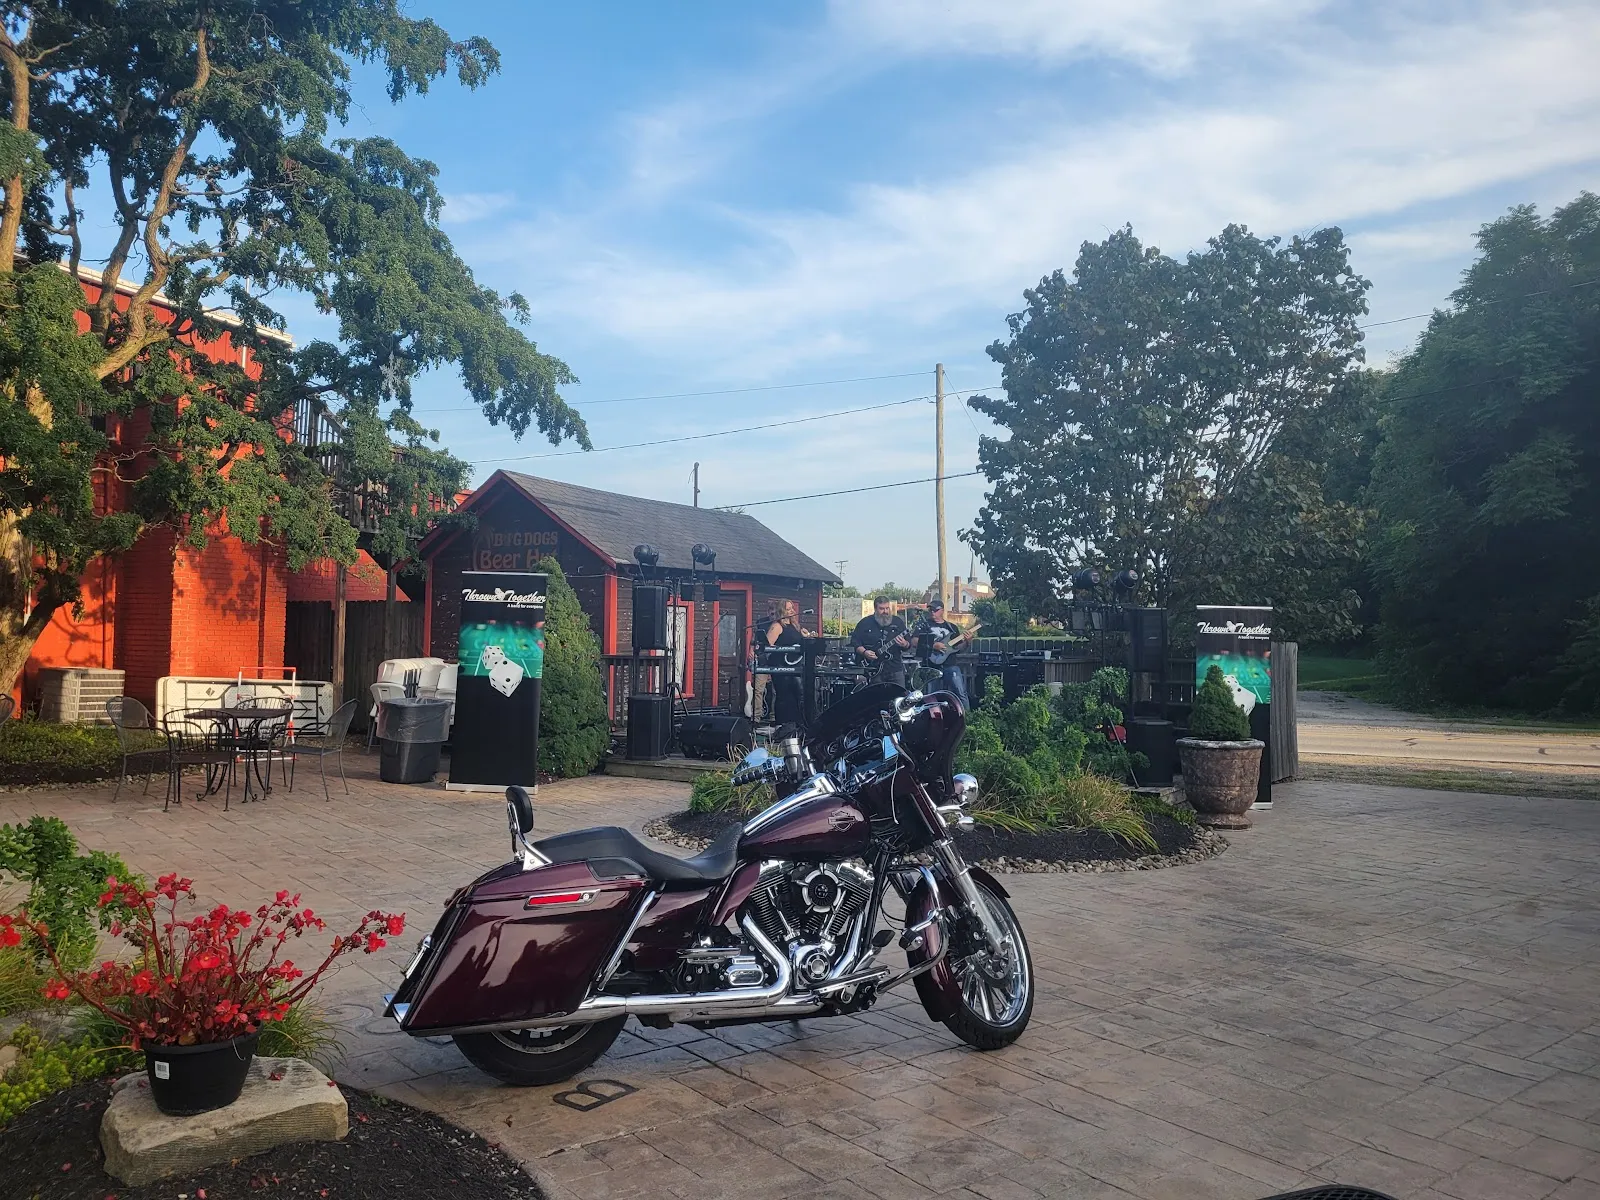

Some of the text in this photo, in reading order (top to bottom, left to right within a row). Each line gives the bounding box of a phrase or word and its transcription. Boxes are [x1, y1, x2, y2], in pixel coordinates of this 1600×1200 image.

[494, 531, 558, 547] BIG DOGS
[480, 549, 521, 569] Beer
[505, 590, 546, 605] Together
[1235, 623, 1271, 637] Together
